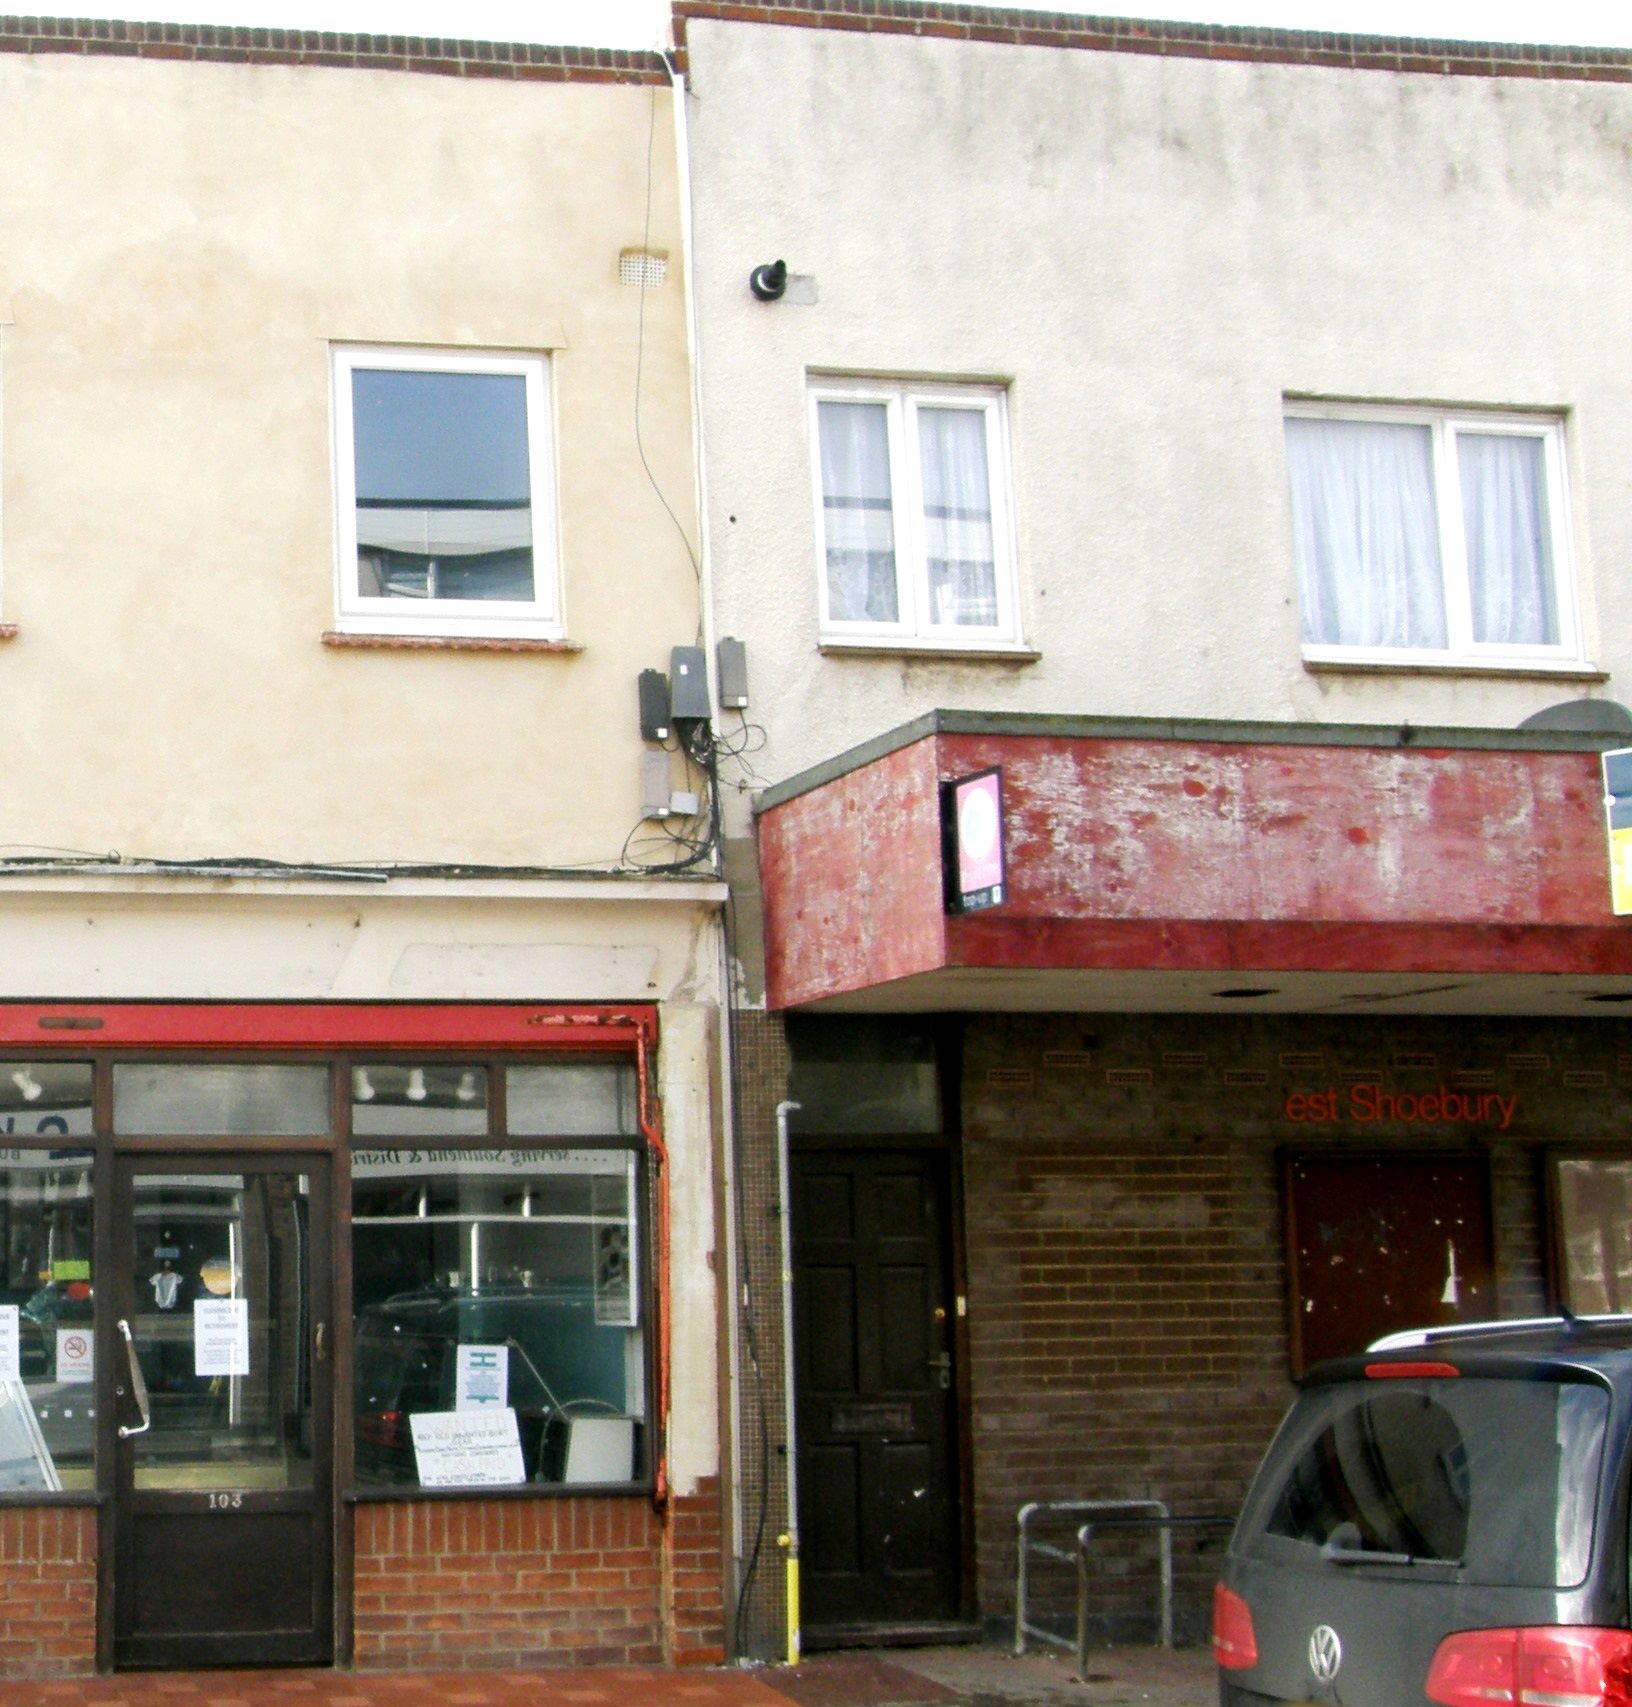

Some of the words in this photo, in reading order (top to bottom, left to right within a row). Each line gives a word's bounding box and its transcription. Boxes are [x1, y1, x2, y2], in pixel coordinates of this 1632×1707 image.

[1284, 1087, 1339, 1122] est
[1349, 1082, 1516, 1130] Shoebury
[209, 1493, 243, 1509] 103
